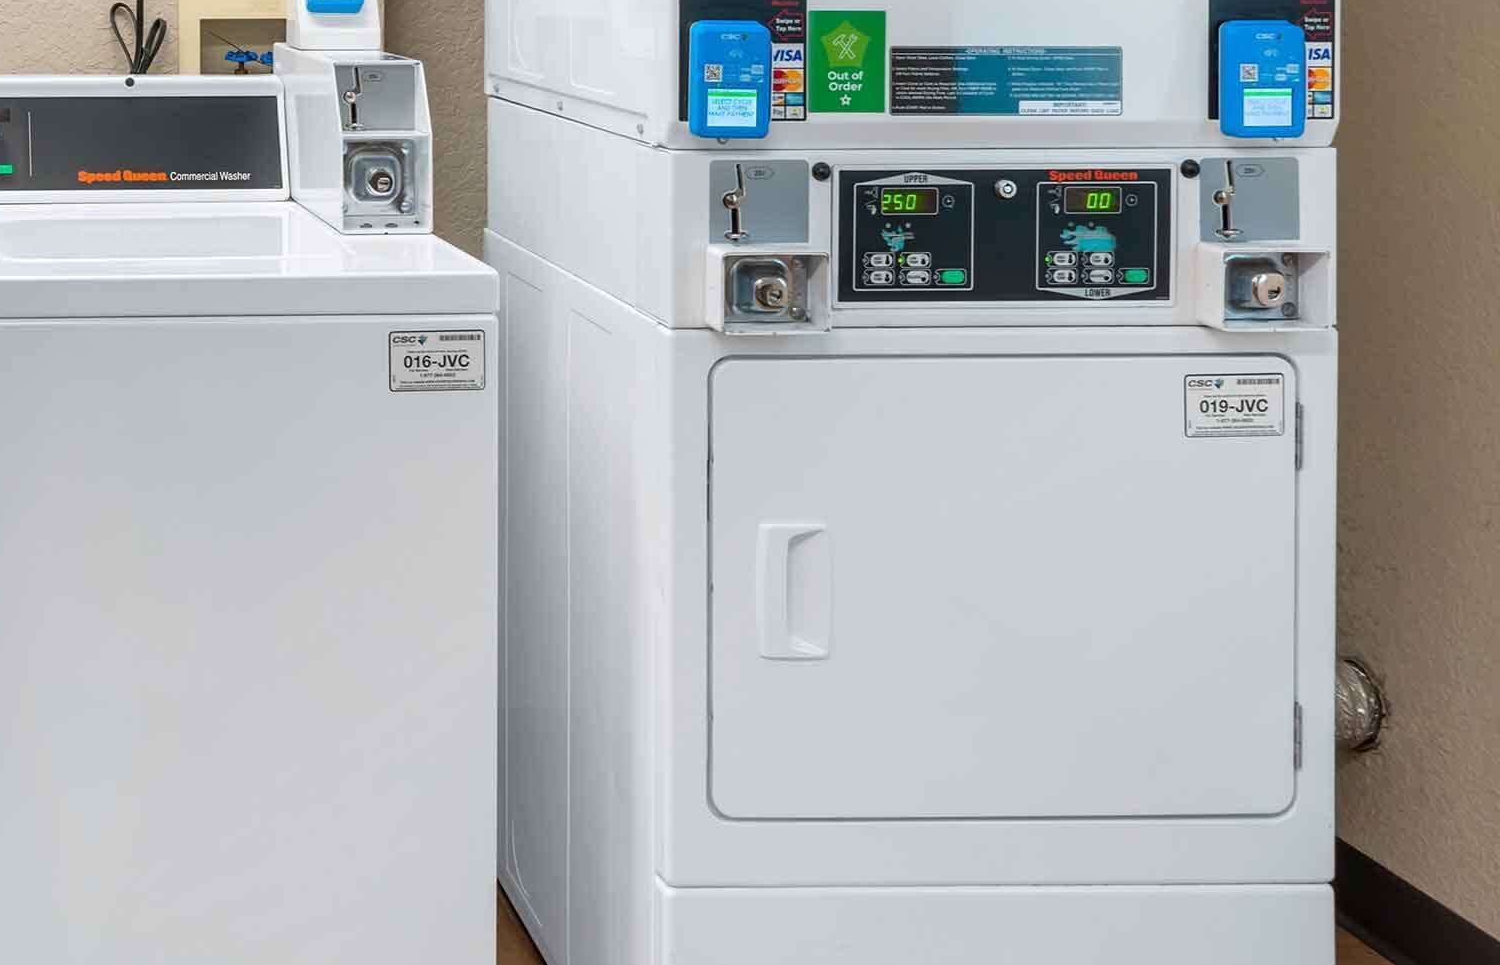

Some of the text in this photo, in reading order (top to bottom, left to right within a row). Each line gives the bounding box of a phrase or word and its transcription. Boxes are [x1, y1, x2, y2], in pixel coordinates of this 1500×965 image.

[1308, 48, 1331, 61] ISA
[827, 70, 864, 81] Out of
[828, 82, 863, 91] Order
[77, 170, 251, 184] Speed Queen Commercial Washer
[903, 175, 928, 183] UPPER
[1048, 170, 1138, 183] Speed Queen
[1086, 192, 1111, 209] 00
[1084, 288, 1111, 297] LOWER
[392, 335, 417, 344] CSC
[403, 354, 470, 368] 016-JVC
[1187, 379, 1213, 388] CSC
[1199, 398, 1269, 413] 019-JVC
